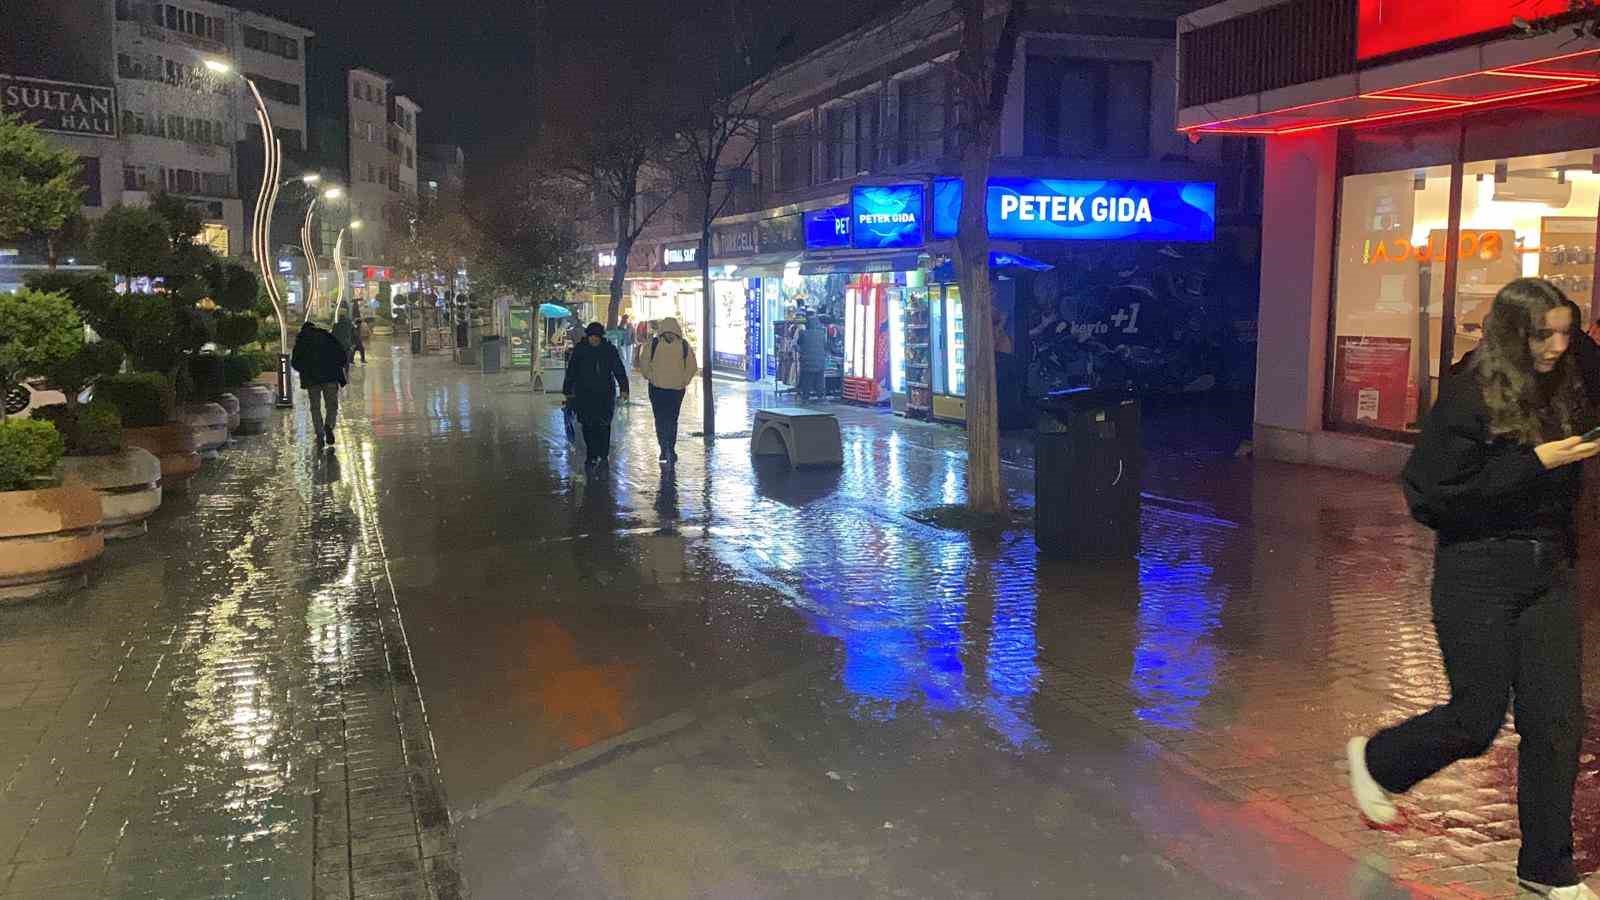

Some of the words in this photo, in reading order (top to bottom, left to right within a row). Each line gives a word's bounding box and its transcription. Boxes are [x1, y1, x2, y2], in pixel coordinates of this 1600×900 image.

[6, 85, 109, 114] SULTAN
[859, 214, 890, 224] PETEK
[892, 212, 916, 223] GIDA
[1000, 194, 1085, 222] PETEK
[1091, 195, 1153, 223] GIDA
[1111, 302, 1141, 334] +1
